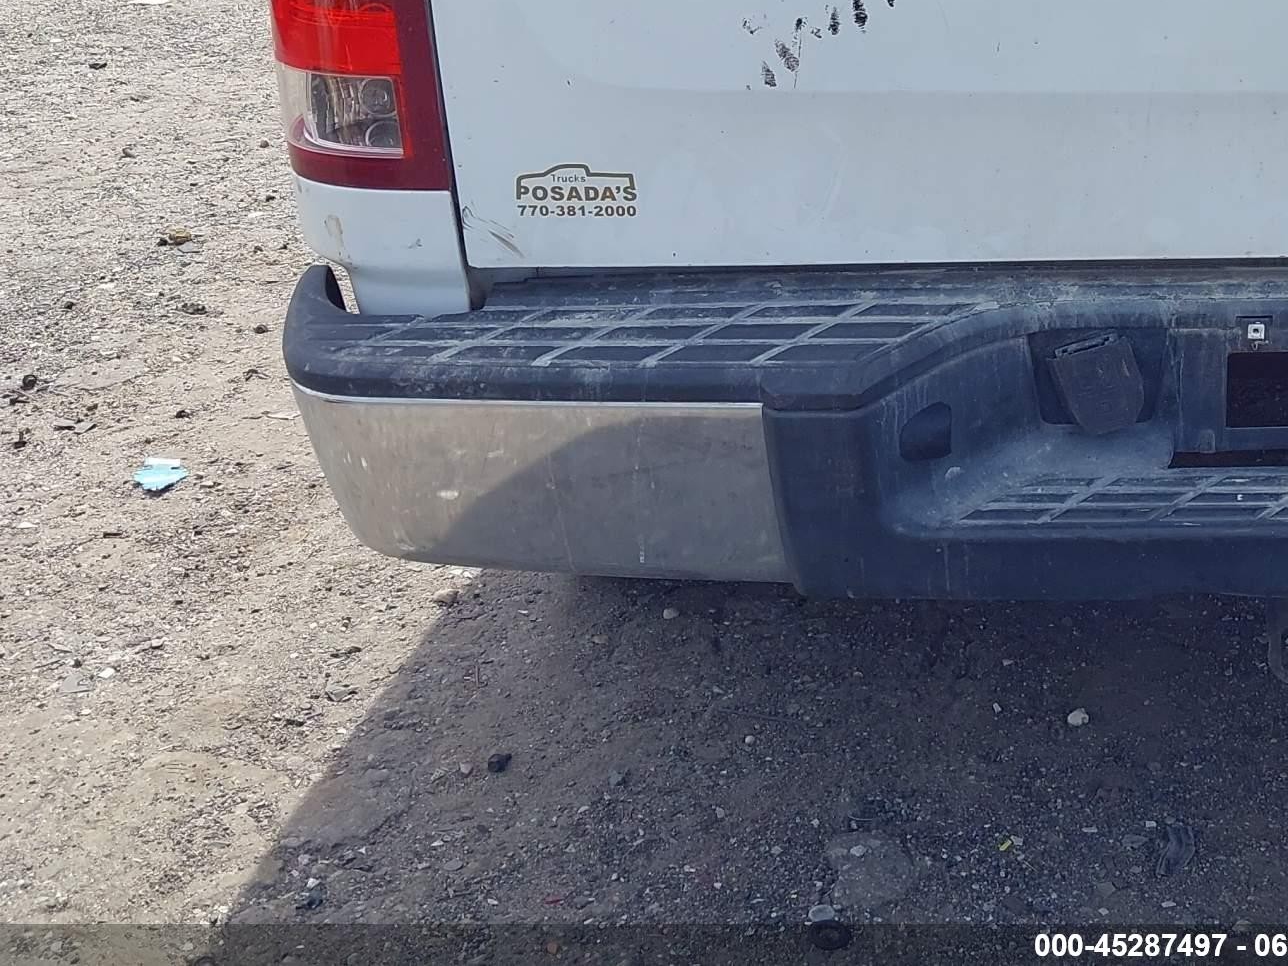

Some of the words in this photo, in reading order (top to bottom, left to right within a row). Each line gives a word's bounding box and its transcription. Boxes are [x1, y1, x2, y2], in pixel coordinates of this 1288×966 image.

[551, 173, 586, 183] Trucks
[517, 185, 637, 202] POSADA'S
[517, 205, 637, 217] 770-381-2000
